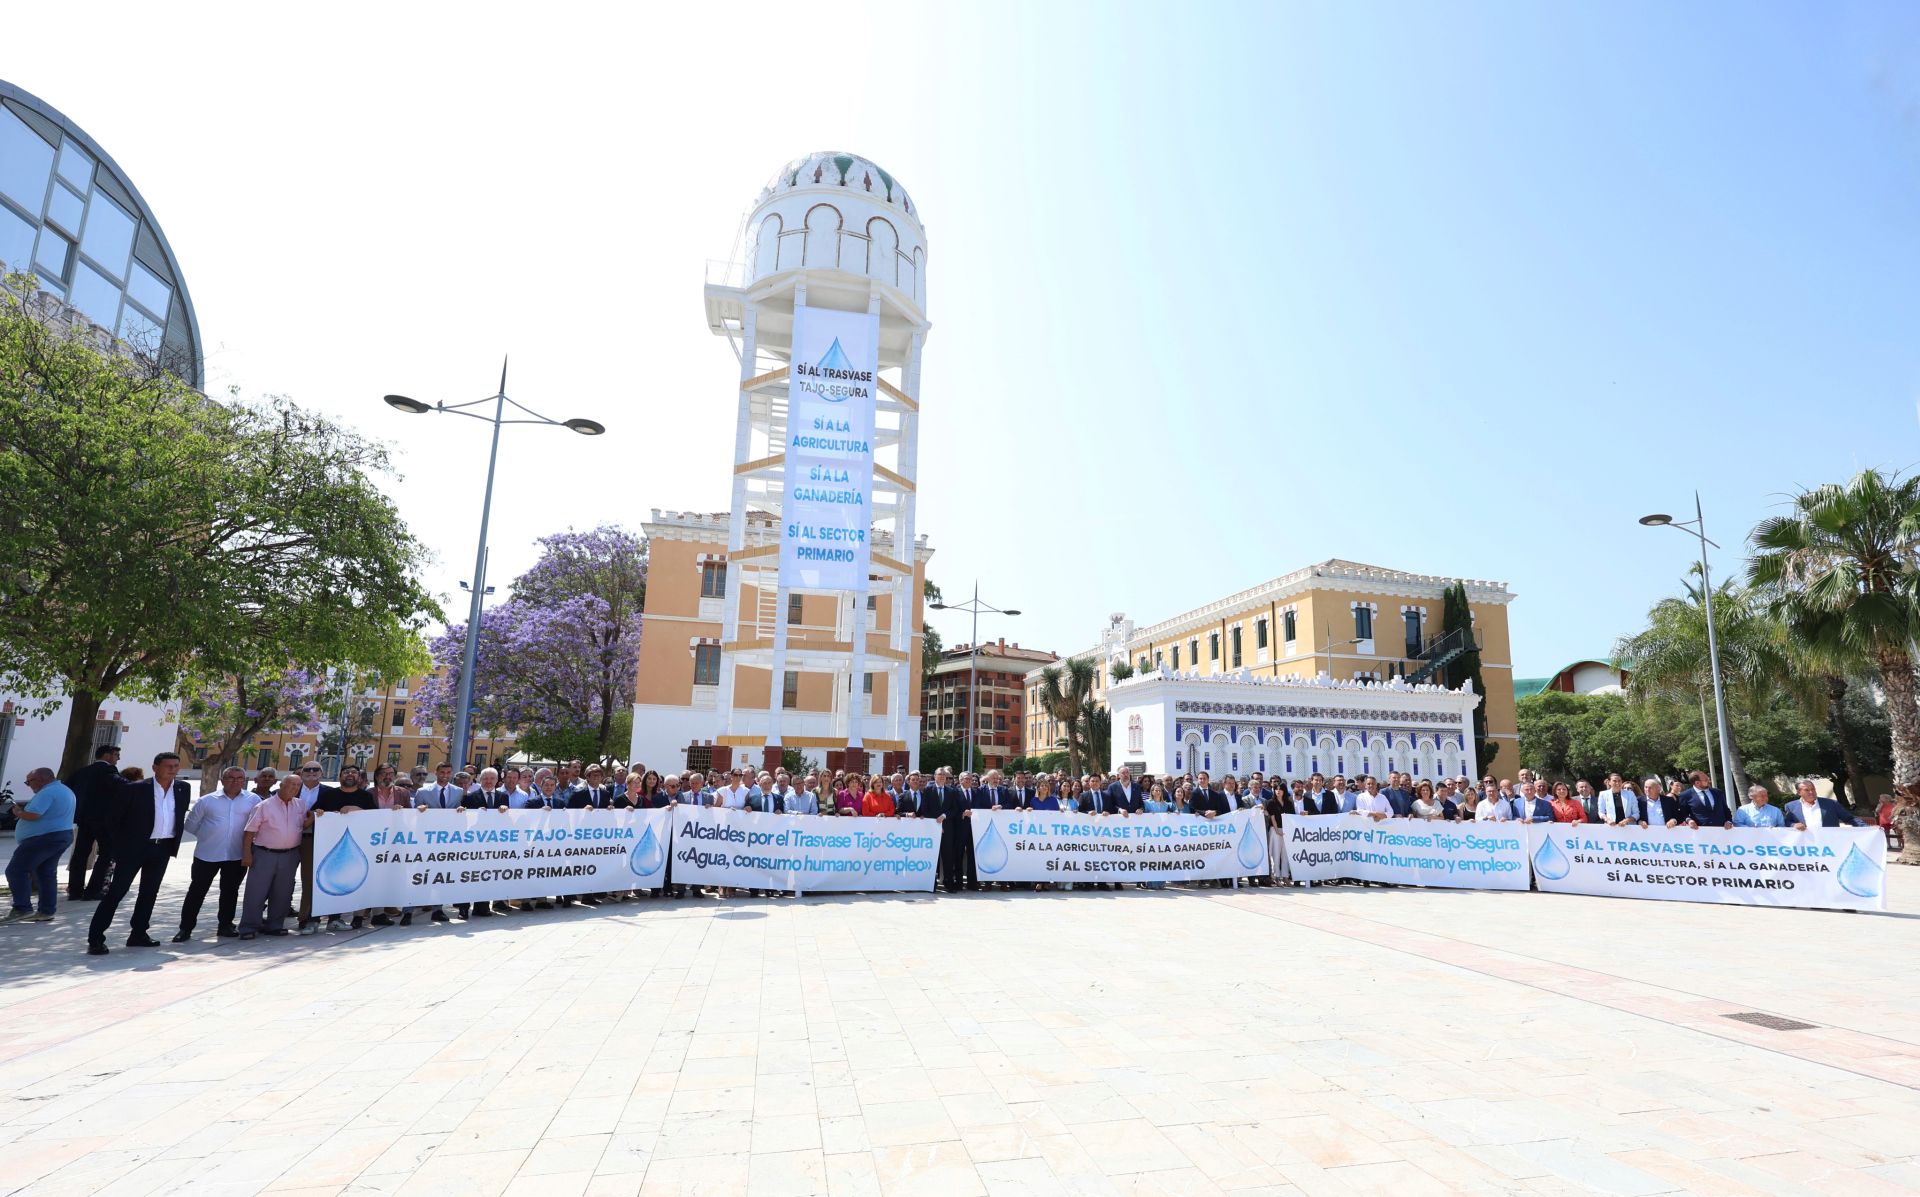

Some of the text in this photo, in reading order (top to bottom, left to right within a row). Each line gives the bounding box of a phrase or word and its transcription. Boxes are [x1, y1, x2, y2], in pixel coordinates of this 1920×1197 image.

[797, 362, 872, 382] SÍ AL TRASVASE
[800, 381, 868, 398] TAJO-SEGURA
[814, 415, 850, 432] SÍ A LA
[792, 435, 869, 453] AGRICULTURA
[810, 464, 849, 482] SÍ A LA
[793, 488, 863, 504] GANADERÍA
[788, 521, 865, 542] SÍ AL SECTOR
[797, 547, 854, 562] PRIMARIO
[370, 827, 634, 846] SÍ AL TRASVASE TAJO-SEGURA
[680, 821, 933, 852] Alcaldes por el Trasvase Tajo-Segura
[1008, 820, 1236, 838] SÍ AL TRASVASE TAJO-SEGURA
[1015, 840, 1231, 854] SÍ A LA AGRICULTURA, SÍ A LA GANADERÍA
[1292, 827, 1519, 853] Alcaldes por el Trasvase Tajo-Segura
[1565, 837, 1835, 857] SÍ AL TRASVASE TAJO-SEGURA
[375, 844, 627, 864] SÍ A LA AGRICULTURA, SÍ A LA GANADERÍA
[677, 847, 932, 875] «Agua, consumo humano y empleo»
[1292, 849, 1521, 874] «Agua, consumo humano y empleo»
[1574, 854, 1584, 863] SÍ
[1597, 856, 1612, 864] LA
[1614, 858, 1700, 869] AGRICULTURA,
[1704, 859, 1714, 869] SÍ
[1730, 862, 1746, 870] LA
[1749, 861, 1830, 872] GANADERÍA
[412, 864, 597, 885] SÍ AL SECTOR PRIMARIO
[1046, 858, 1205, 872] SÍ AL SECTOR PRIMARIO
[1607, 870, 1795, 890] SÍ AL SECTOR PRIMARIO
